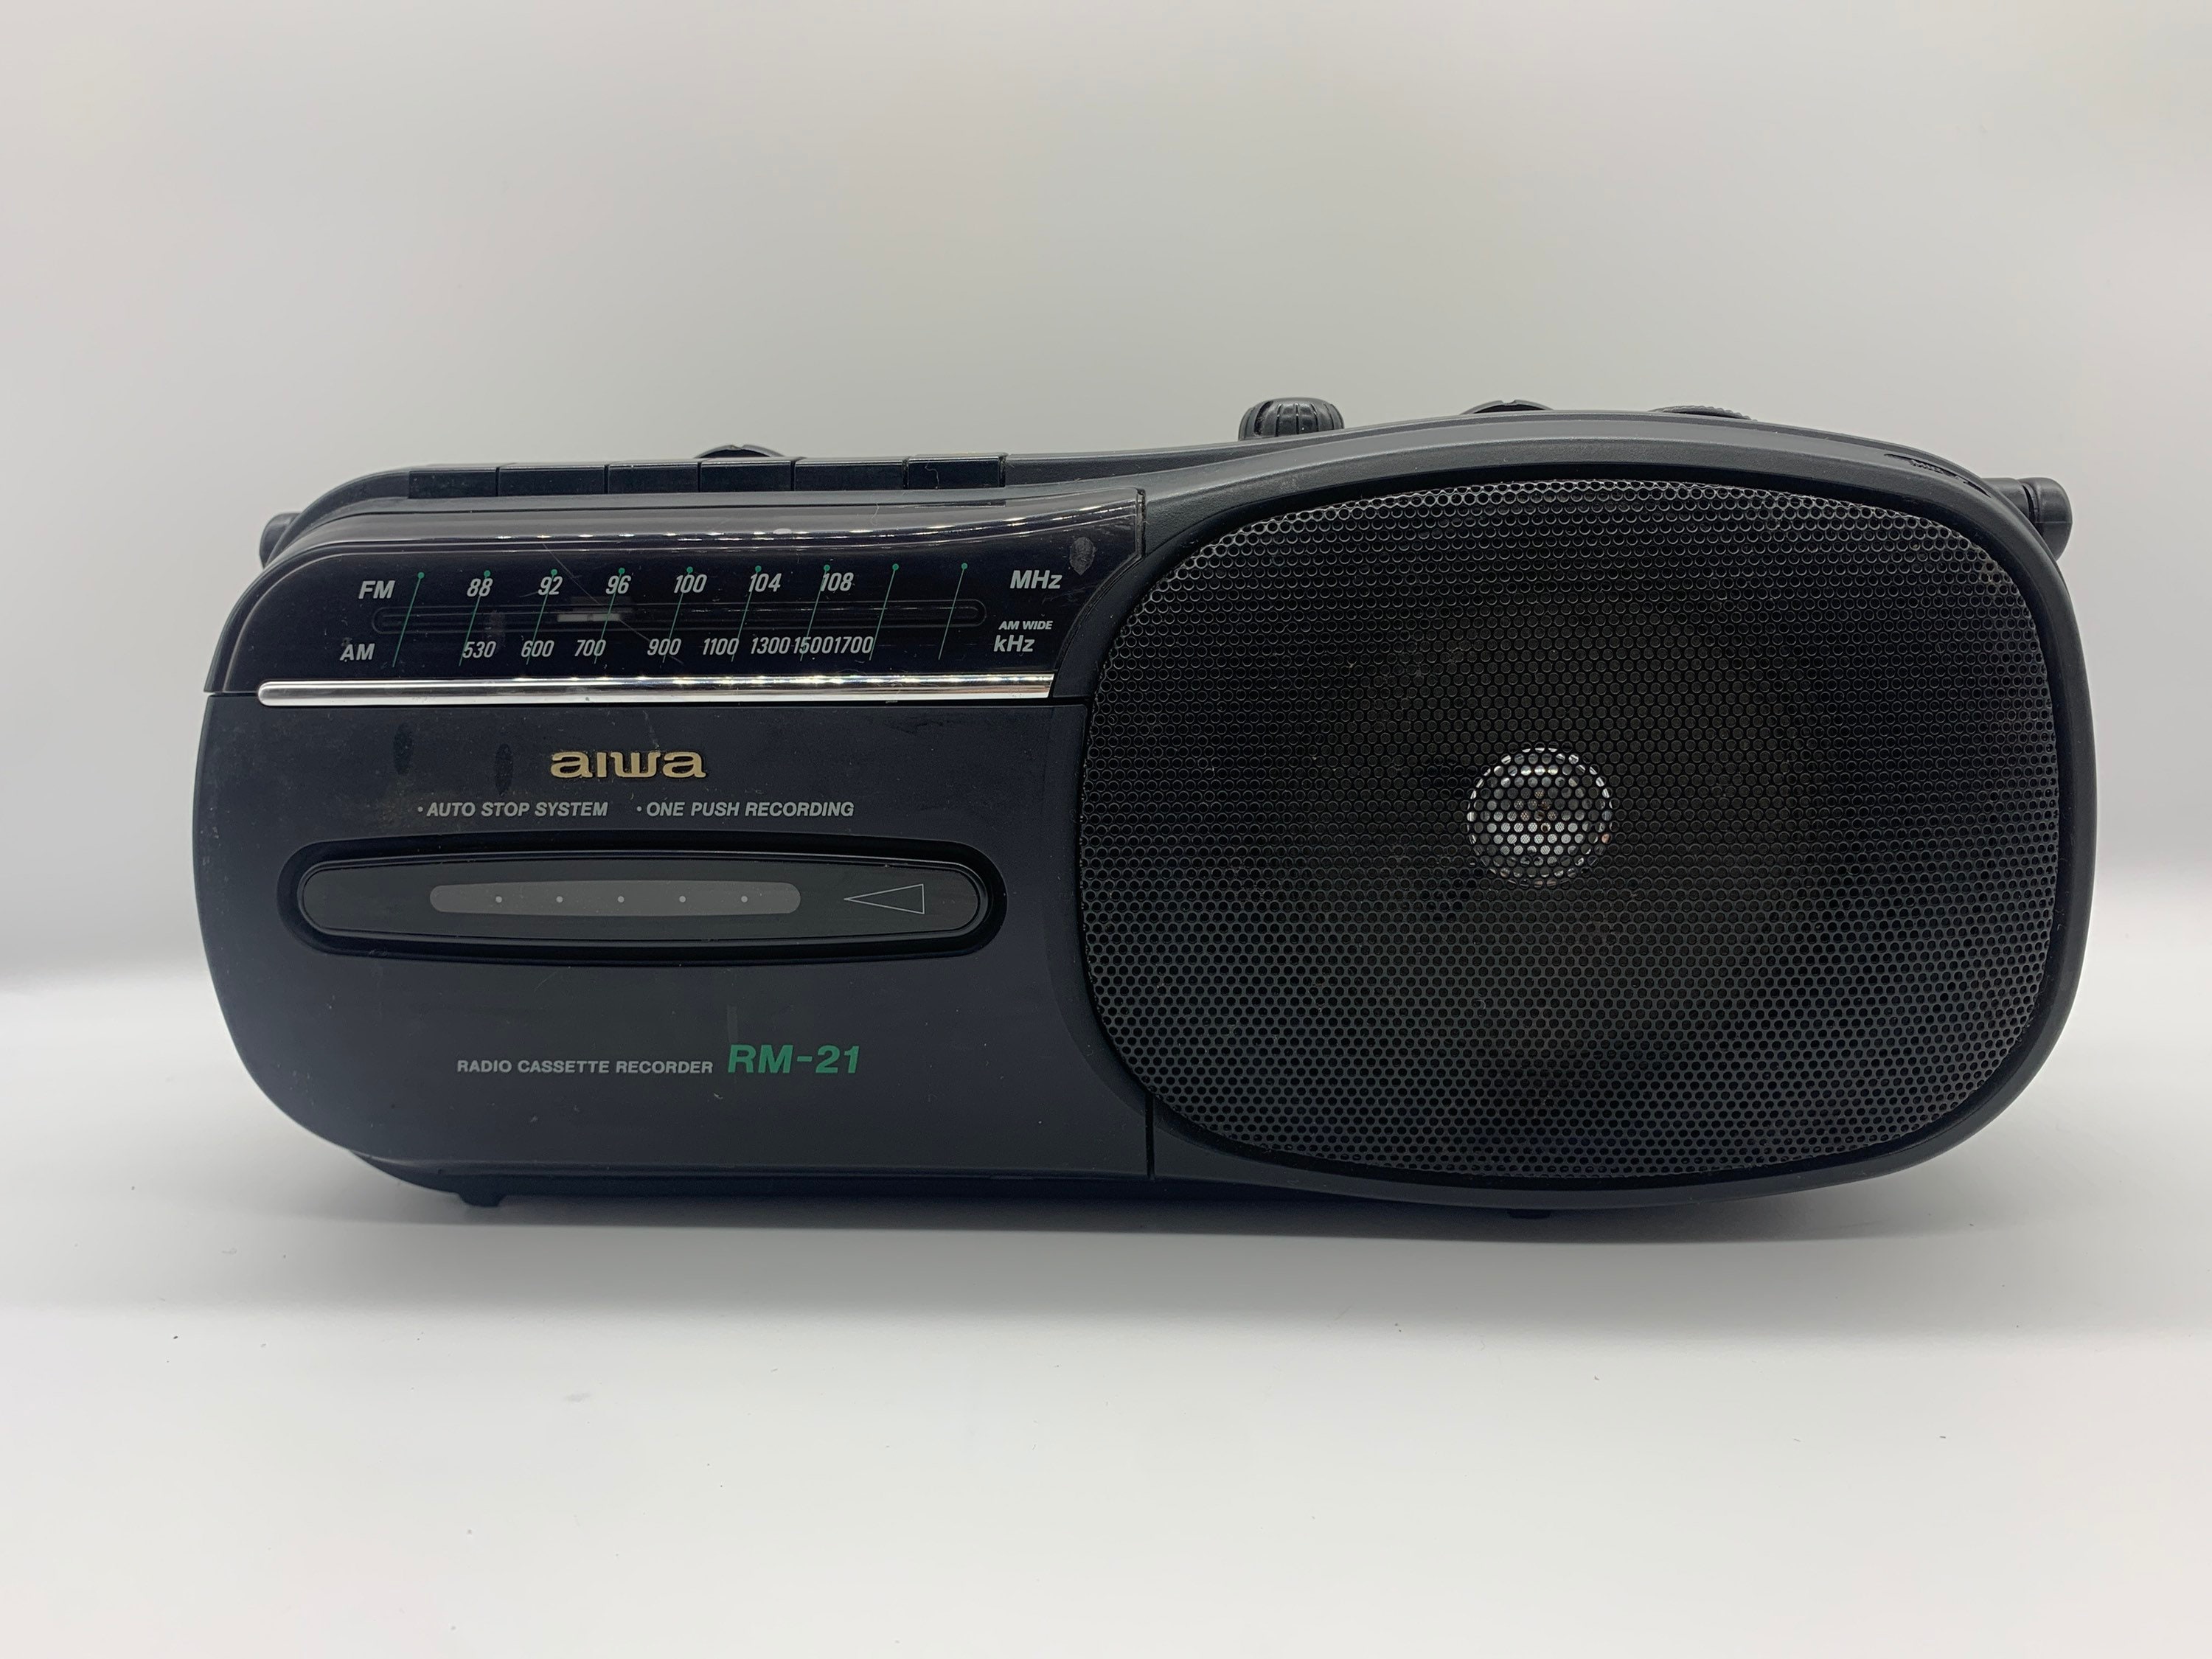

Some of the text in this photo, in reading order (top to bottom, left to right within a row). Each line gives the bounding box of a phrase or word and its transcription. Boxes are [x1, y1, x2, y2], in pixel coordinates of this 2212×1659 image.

[358, 570, 1062, 599] FM 88 92 96 100 104 108 MHz
[999, 620, 1053, 630] AM WIDE
[340, 634, 1035, 661] AM 530 600 700 900 1100 1300 1500 1700 kHz
[550, 751, 706, 779] aiwa
[481, 801, 530, 818] STOP
[535, 801, 608, 817] SYSTEM
[690, 801, 739, 817] PUSH
[745, 801, 855, 818] RECORDING
[457, 1044, 860, 1074] RADIO CASSETTE RECORDER RM-21
